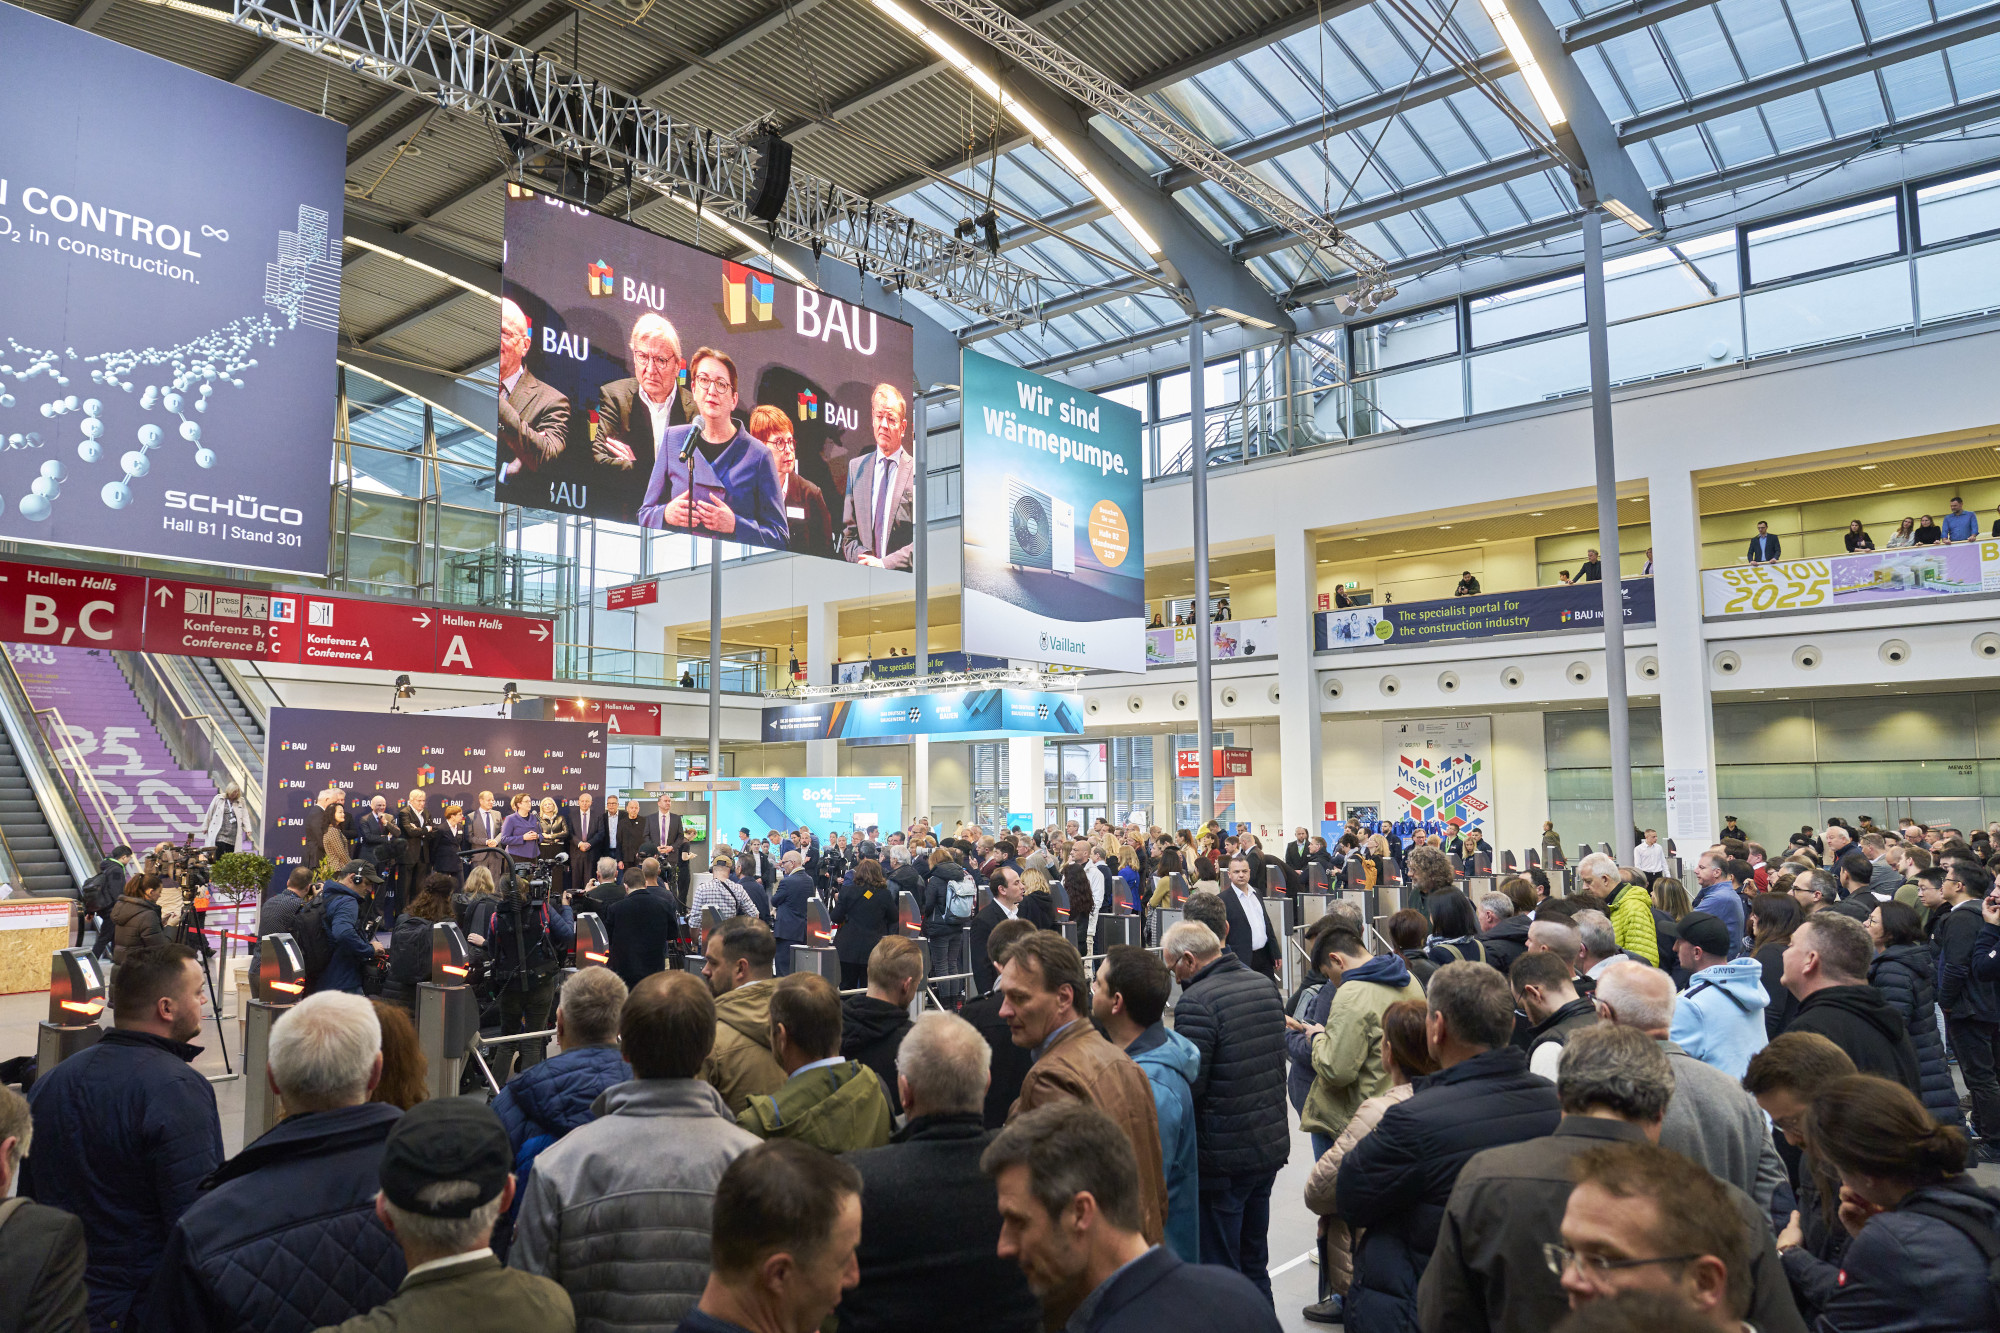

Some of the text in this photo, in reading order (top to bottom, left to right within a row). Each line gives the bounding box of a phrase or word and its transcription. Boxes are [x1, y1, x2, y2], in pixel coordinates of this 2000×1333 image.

[29, 223, 50, 246] in
[57, 236, 200, 285] construction.
[623, 276, 665, 311] BAU
[796, 285, 878, 356] BAU
[542, 326, 589, 361] BAU
[1016, 380, 1100, 434] Wir sind
[824, 401, 858, 430] BAU
[982, 405, 1129, 477] Wärmepumpe.
[164, 490, 303, 526] SCHÜCO
[163, 516, 193, 533] Hall
[197, 520, 216, 536] B1
[231, 525, 273, 544] Stand
[276, 532, 302, 547] 301
[1722, 560, 1830, 587] SEE YOU
[27, 570, 118, 592] Hallen Halls
[215, 596, 240, 606] press
[1724, 578, 1831, 614] 2025
[223, 606, 239, 615] West
[1398, 599, 1520, 622] The specialist portal for
[1574, 609, 1594, 621] BAU
[23, 593, 116, 645] B,C
[442, 614, 503, 631] Hallen Halls
[1399, 615, 1530, 636] the construction industry
[183, 618, 279, 638] Konferenz B, C
[182, 635, 282, 654] Conference B, C
[307, 633, 370, 648] Konferenz A
[1049, 635, 1086, 655] Vaillant
[306, 647, 374, 662] Conference A
[441, 634, 474, 669] A
[878, 664, 889, 673] The
[889, 661, 916, 675] specialist
[935, 658, 945, 668] for
[607, 713, 621, 733] A
[291, 742, 308, 751] BAU
[340, 744, 356, 752] BAU
[386, 746, 401, 754] BAU
[430, 747, 445, 755] BAU
[473, 748, 486, 756] BAU
[588, 751, 601, 759] BAU
[315, 762, 331, 770] BAU
[363, 763, 378, 771] BAU
[532, 766, 545, 774] BAU
[570, 767, 582, 775] BAU
[289, 780, 306, 788] BAU
[441, 769, 472, 786] BAU
[1398, 765, 1464, 794] Meet Italy
[339, 781, 354, 789] BAU
[385, 782, 400, 790] BAU
[512, 783, 525, 791] BAU
[550, 783, 563, 791] BAU
[587, 783, 600, 791] BAU
[1445, 778, 1477, 803] at Bau
[802, 788, 834, 801] 80%
[361, 799, 372, 808] BA
[450, 799, 464, 808] BAU
[1464, 796, 1485, 810] 2023
[288, 818, 304, 826] BAU
[432, 817, 442, 825] AU
[286, 856, 302, 864] BAU
[385, 890, 395, 898] AU
